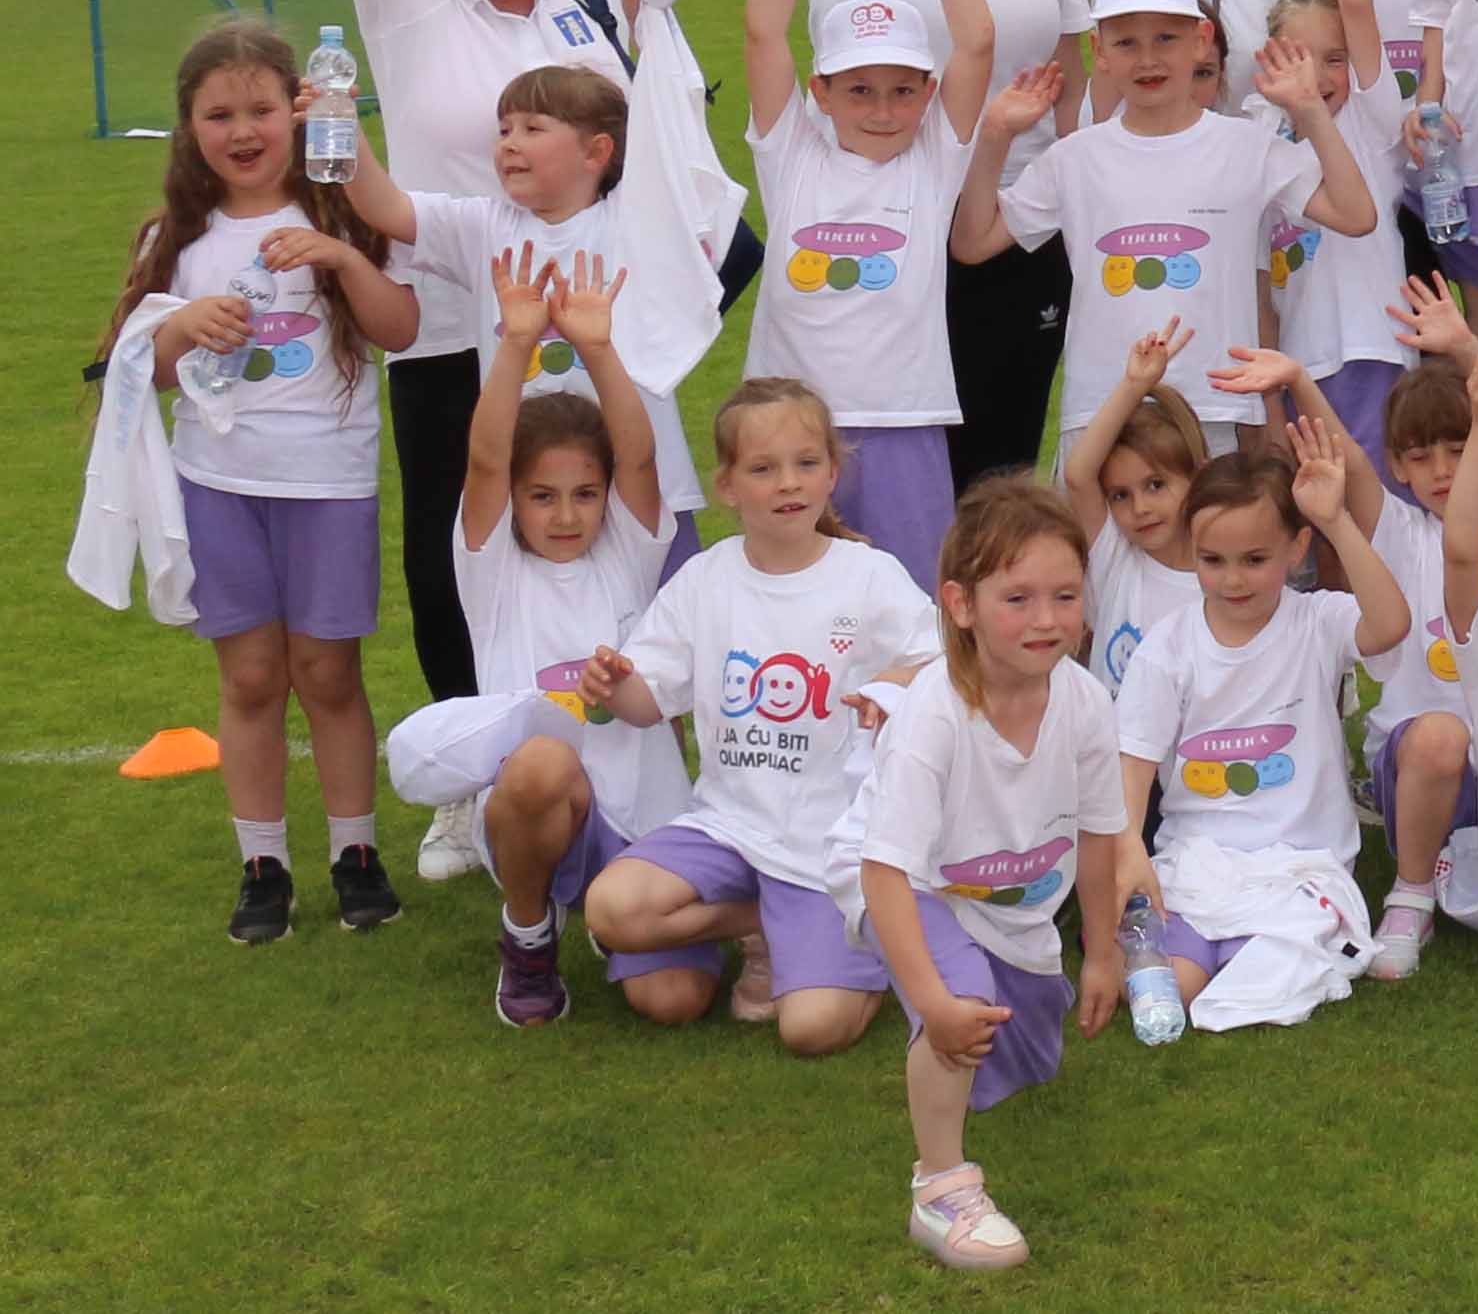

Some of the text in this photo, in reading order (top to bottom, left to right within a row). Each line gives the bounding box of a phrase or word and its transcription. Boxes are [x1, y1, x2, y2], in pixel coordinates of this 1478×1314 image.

[723, 726, 739, 744] JA
[745, 723, 771, 746] ĆU
[777, 732, 810, 752] BITI
[719, 748, 803, 774] OLIMPIJAC
